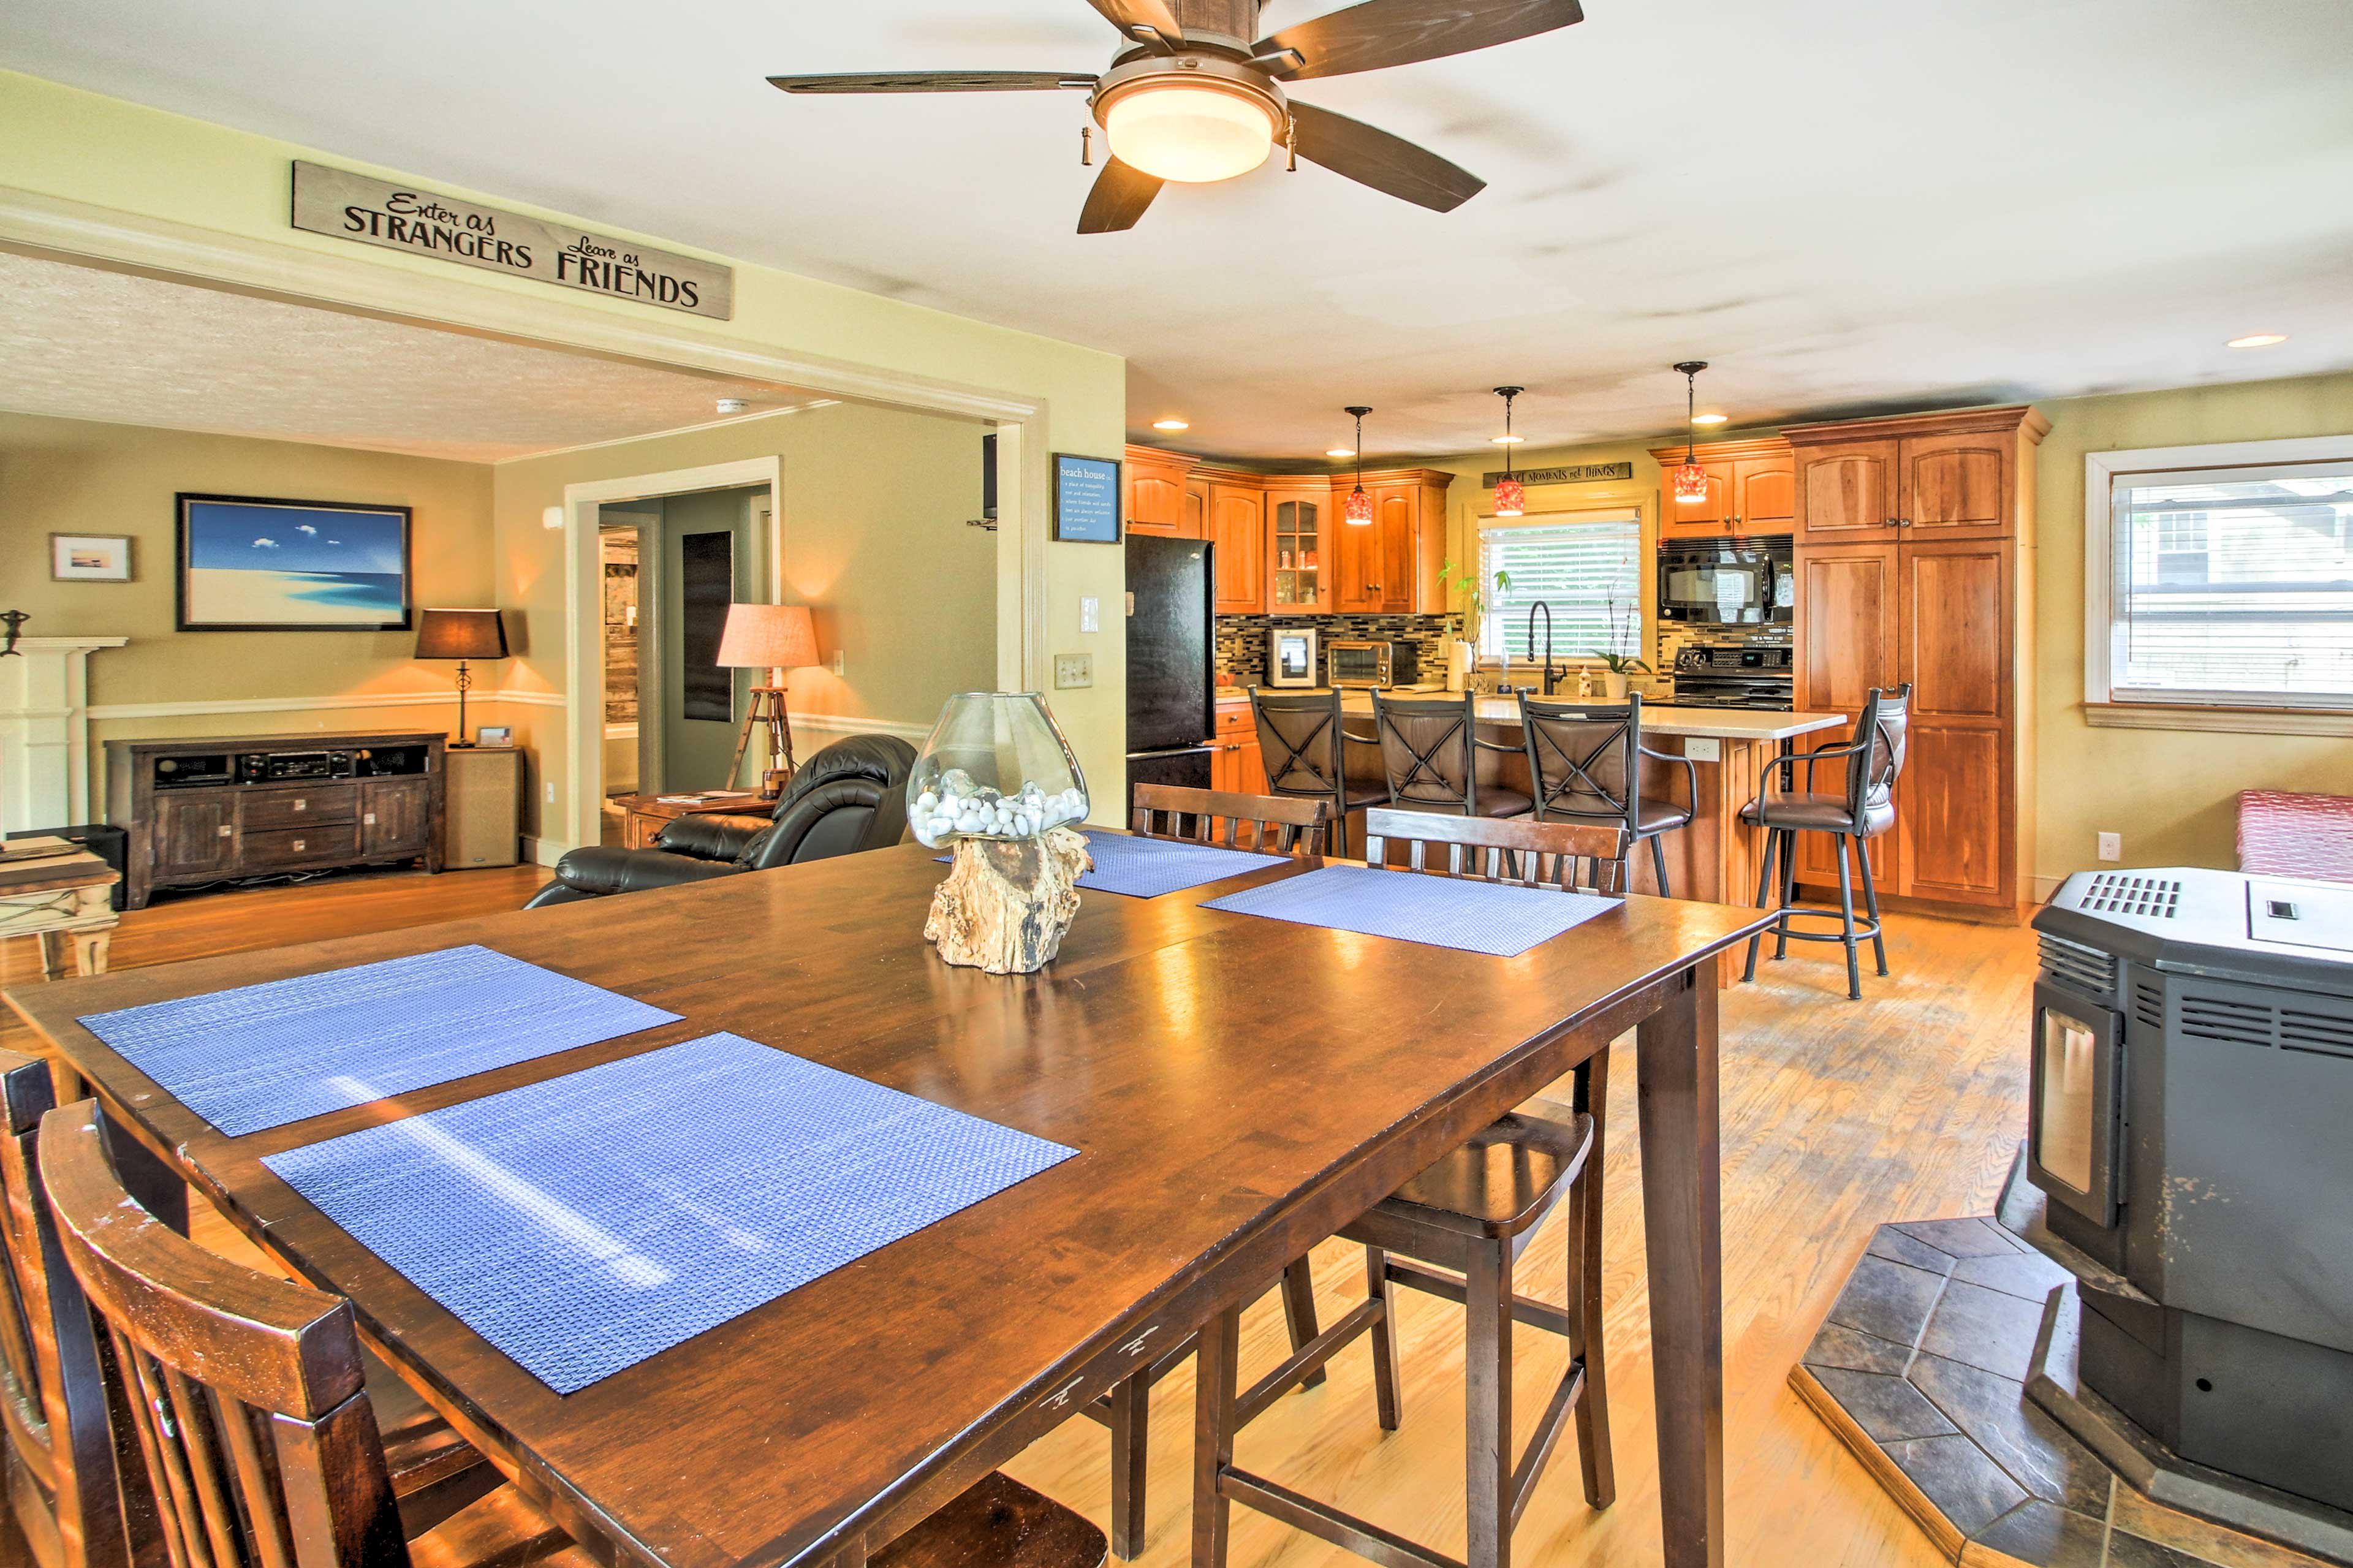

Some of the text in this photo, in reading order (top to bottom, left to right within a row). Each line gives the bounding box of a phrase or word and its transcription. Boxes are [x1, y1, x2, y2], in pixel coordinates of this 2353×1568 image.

[385, 192, 495, 236] Enter as
[344, 205, 533, 269] STRANGERS
[567, 235, 639, 267] Leave as
[557, 250, 699, 308] FRIENDS
[1060, 466, 1083, 477] beach
[1084, 468, 1106, 480] house
[1528, 469, 1567, 483] MOMENTS
